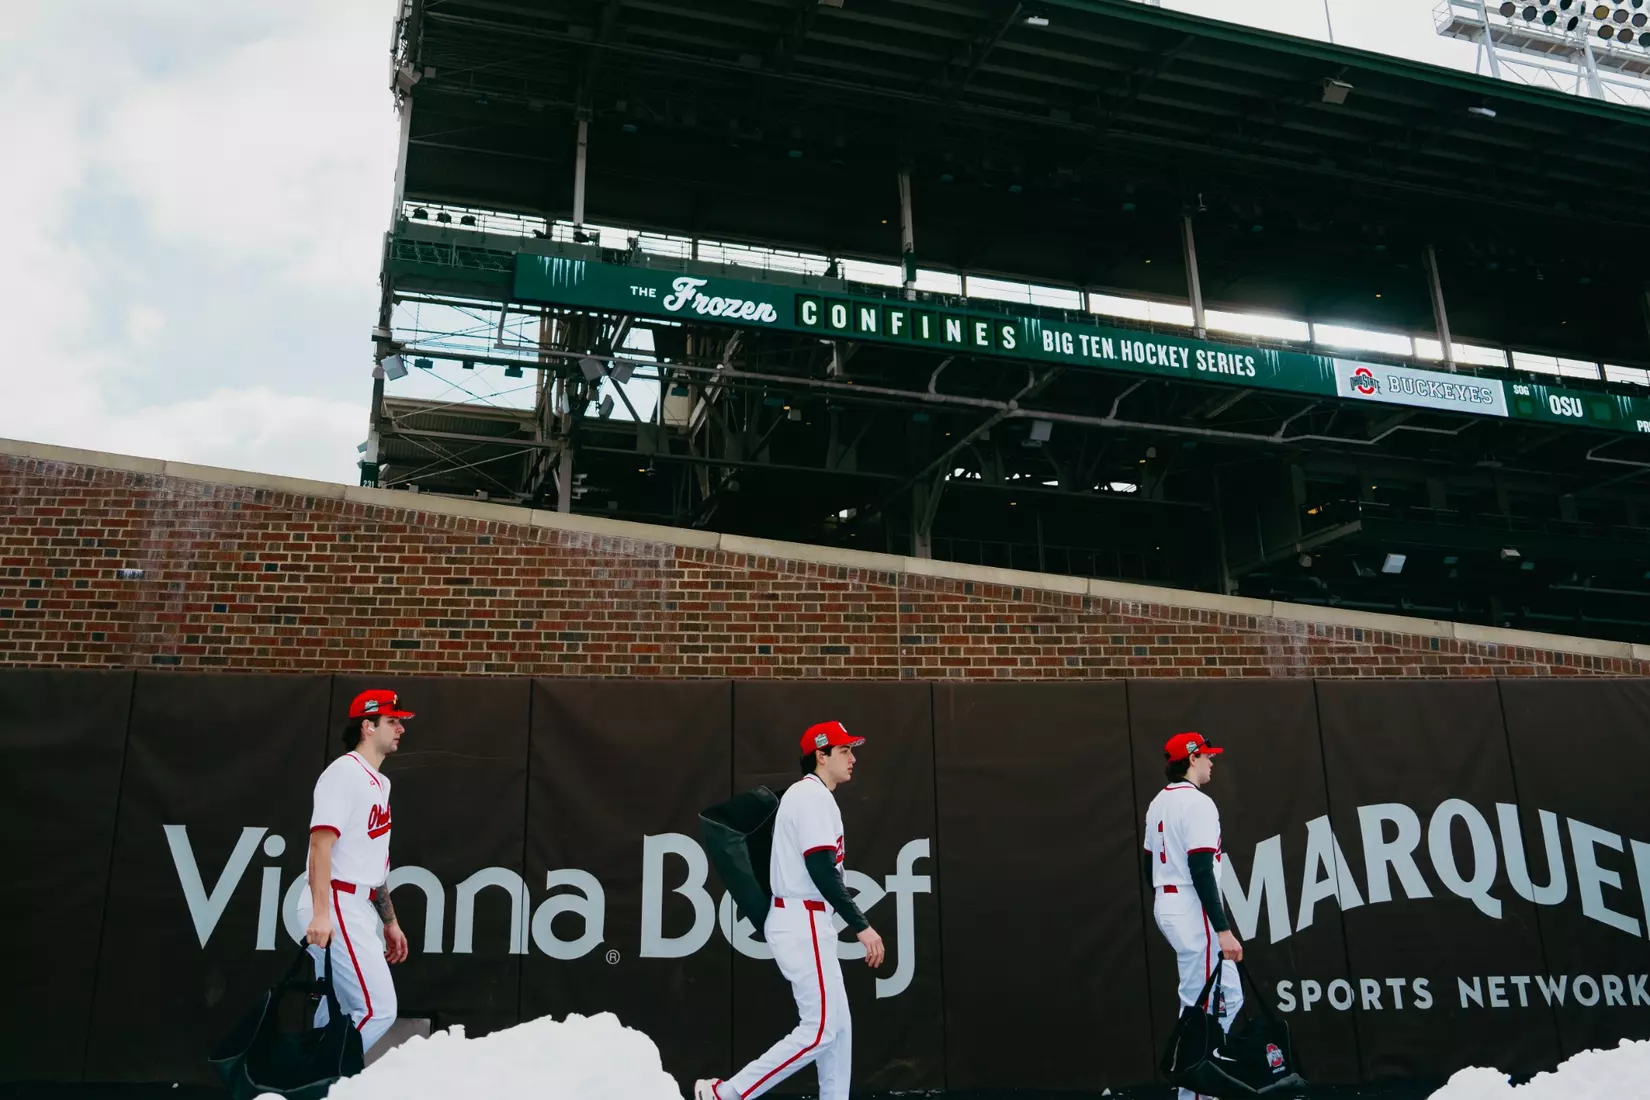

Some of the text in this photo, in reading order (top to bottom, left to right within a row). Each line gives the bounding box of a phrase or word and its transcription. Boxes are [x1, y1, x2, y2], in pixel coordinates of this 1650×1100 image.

[630, 276, 1017, 350] THE Frozen CONFINES
[1042, 329, 1074, 355] BIG
[1121, 340, 1190, 369] HOCKEY
[1196, 350, 1256, 377] SERIES
[1387, 375, 1494, 405] BUCKEYES
[1513, 384, 1530, 396] SOG
[1549, 395, 1584, 418] OSU
[1636, 419, 1650, 432] PR
[163, 824, 605, 960] Vinna
[1276, 973, 1650, 1013] SPORTS NETWORK
